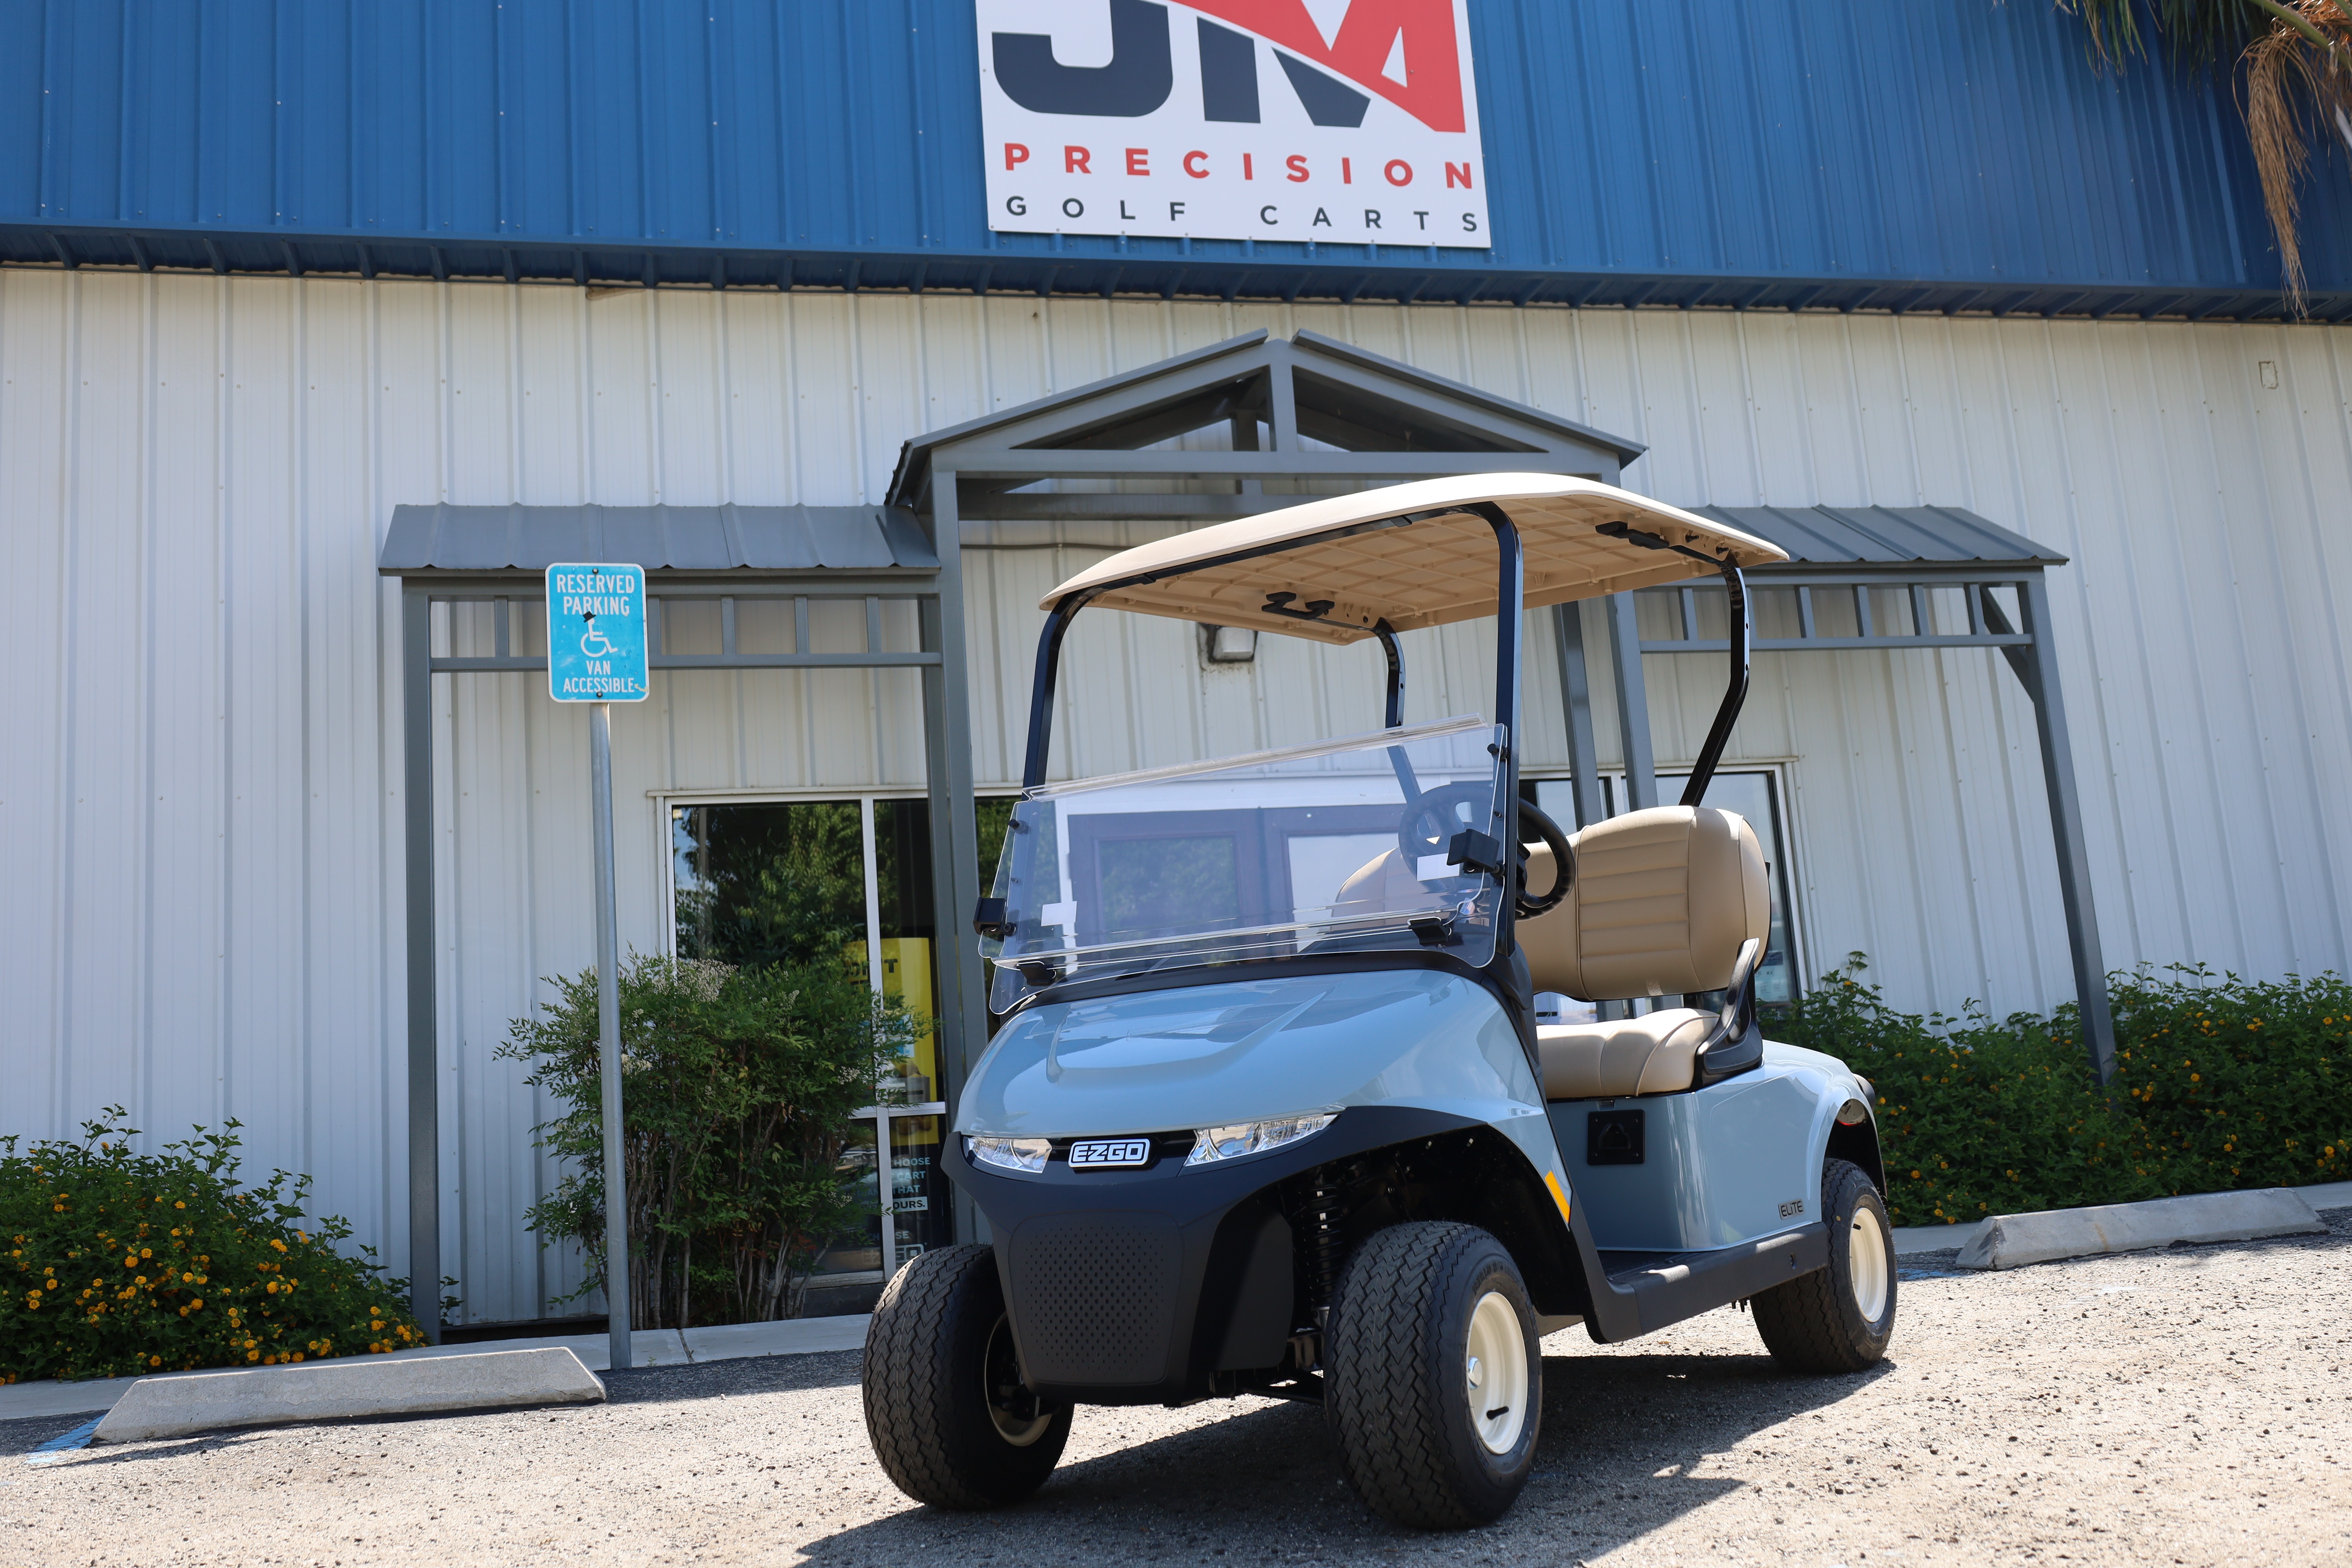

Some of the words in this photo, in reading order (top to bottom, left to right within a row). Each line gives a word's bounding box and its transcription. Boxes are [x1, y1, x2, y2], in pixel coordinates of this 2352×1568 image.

[1004, 142, 1472, 189] PRECISION
[1006, 196, 1185, 221] GOLF
[1260, 205, 1477, 232] CARTS
[557, 574, 635, 593] RESERVED
[563, 596, 629, 615] PARKING
[586, 660, 611, 675] VAN
[563, 678, 635, 693] ACCESSIBLE
[1072, 1143, 1144, 1162] EZGO
[891, 1157, 931, 1167] HOOSE
[897, 1171, 926, 1181] CART
[893, 1185, 920, 1194] THAT
